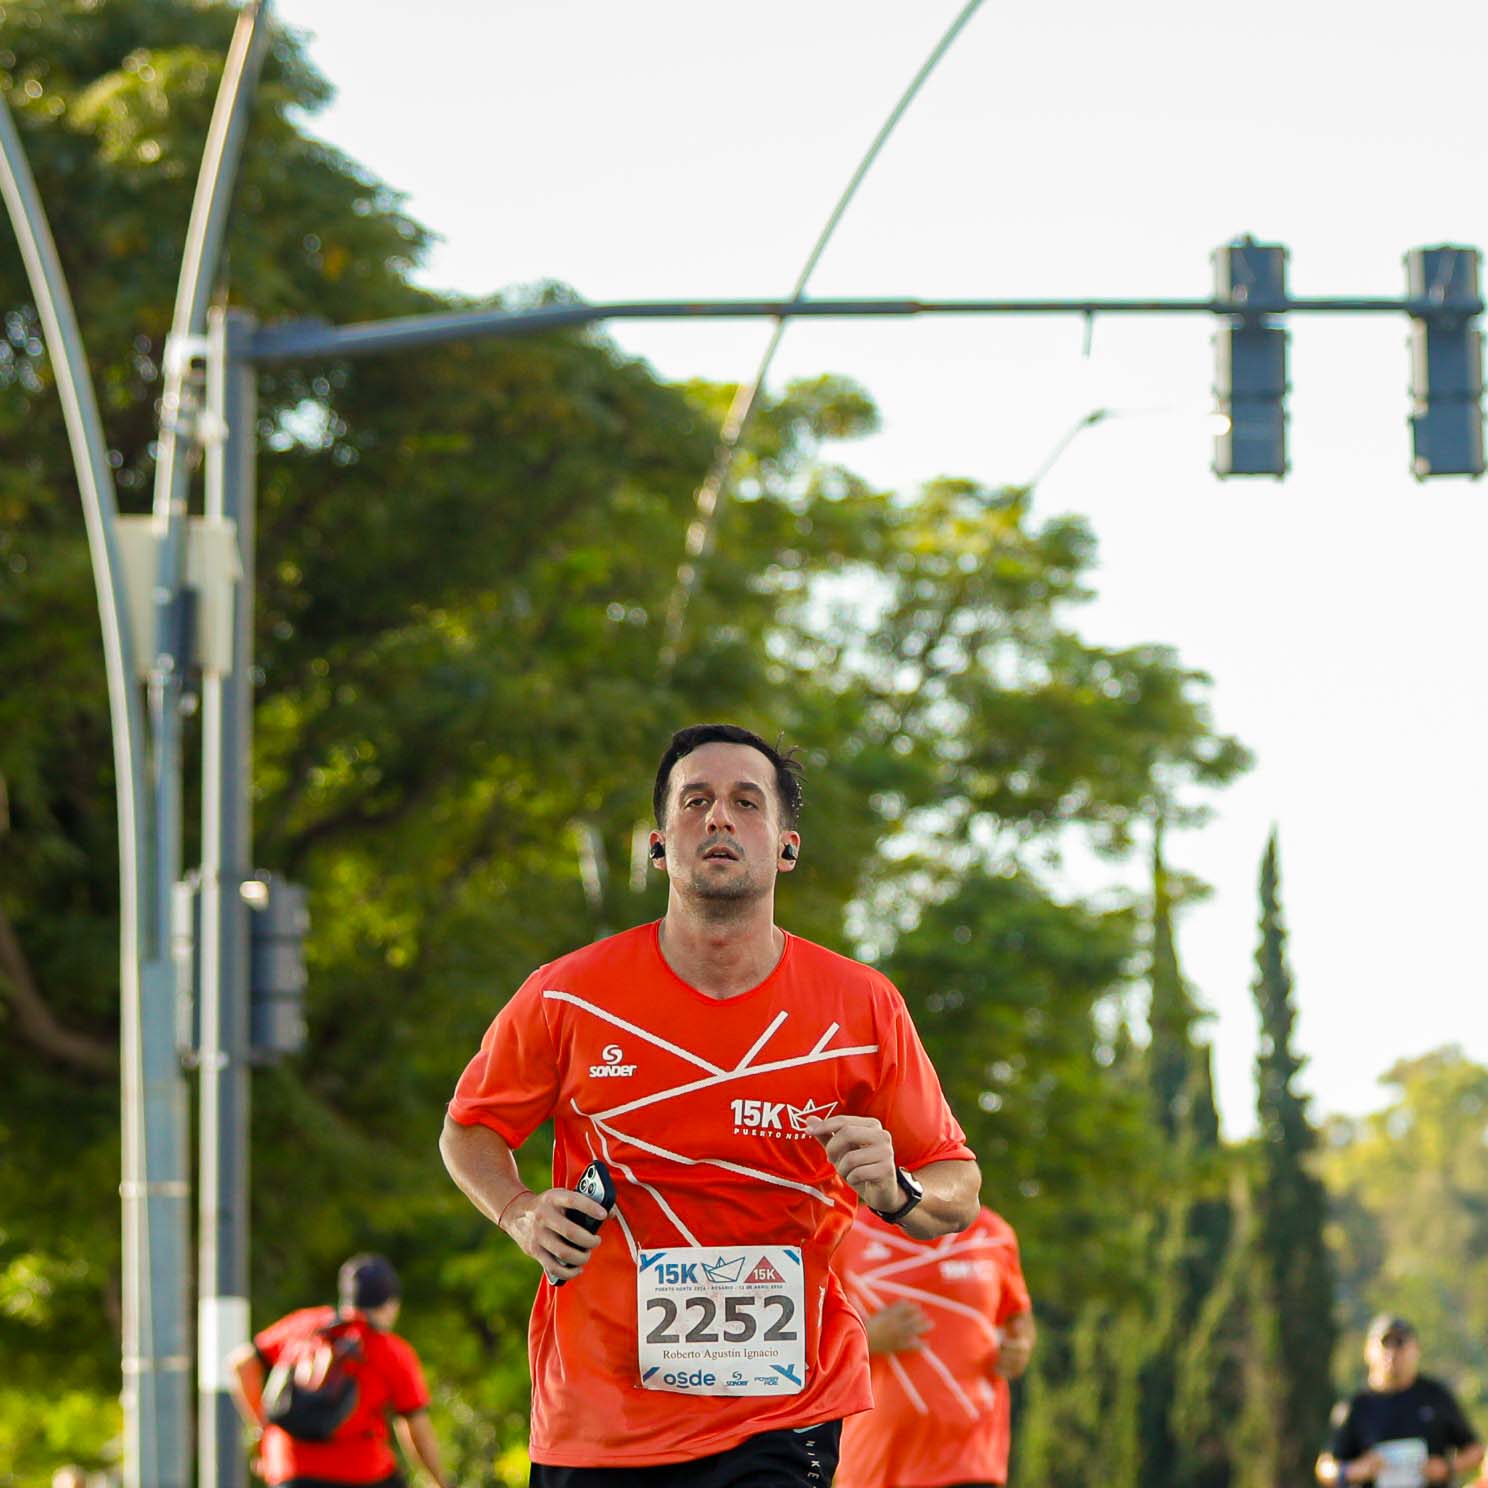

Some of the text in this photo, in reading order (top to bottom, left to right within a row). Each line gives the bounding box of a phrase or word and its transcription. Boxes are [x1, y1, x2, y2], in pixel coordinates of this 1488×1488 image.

[730, 1099, 785, 1129] 15K
[734, 1127, 782, 1139] PUERTO
[654, 1263, 698, 1284] 15K
[753, 1268, 776, 1280] 15K
[646, 1295, 797, 1343] 2252
[663, 1350, 701, 1360] Roberto
[743, 1348, 779, 1361] Ignacio
[663, 1369, 716, 1388] osde
[806, 1440, 821, 1479] NIKE
